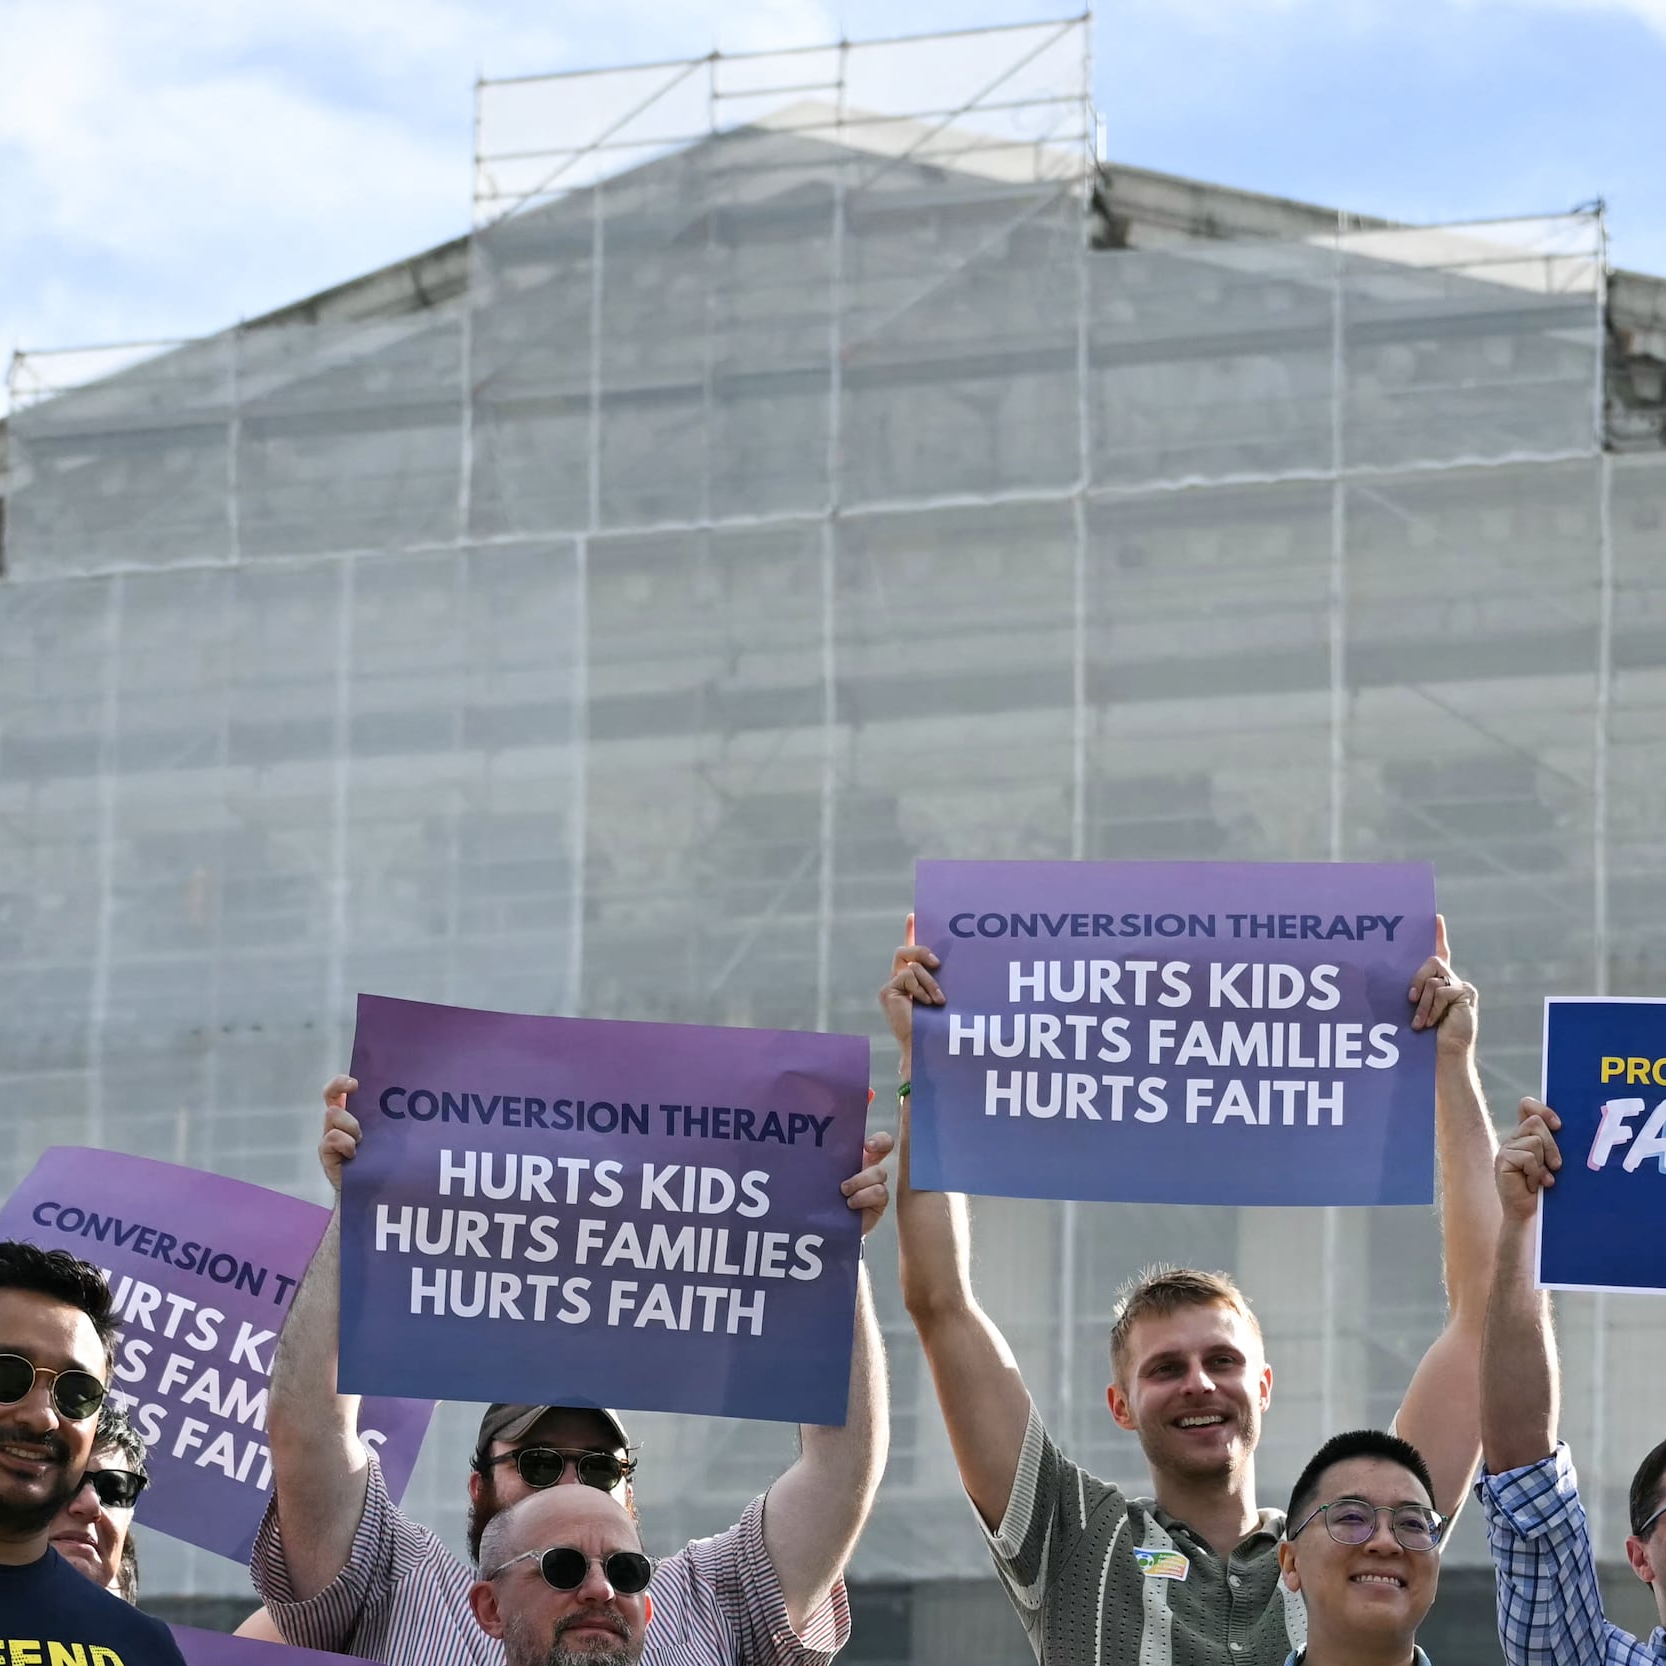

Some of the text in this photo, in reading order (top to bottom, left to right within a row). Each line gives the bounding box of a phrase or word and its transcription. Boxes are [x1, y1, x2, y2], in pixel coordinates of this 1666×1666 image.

[949, 912, 1405, 942] CONVERSION THERAPY
[1009, 960, 1341, 1012] HURTS KIDS
[948, 1014, 1400, 1070] HURTS FAMILIES
[379, 1086, 834, 1148] CONVERSION THERAPY
[984, 1070, 1344, 1127] HURTS FAITH
[438, 1149, 770, 1219] HURTS KIDS
[32, 1201, 268, 1299] CONVERSION
[375, 1203, 824, 1282] HURTS FAMILIES
[102, 1269, 226, 1352] URTS
[410, 1267, 766, 1337] HURTS FAITH
[172, 1417, 275, 1492] FAIT
